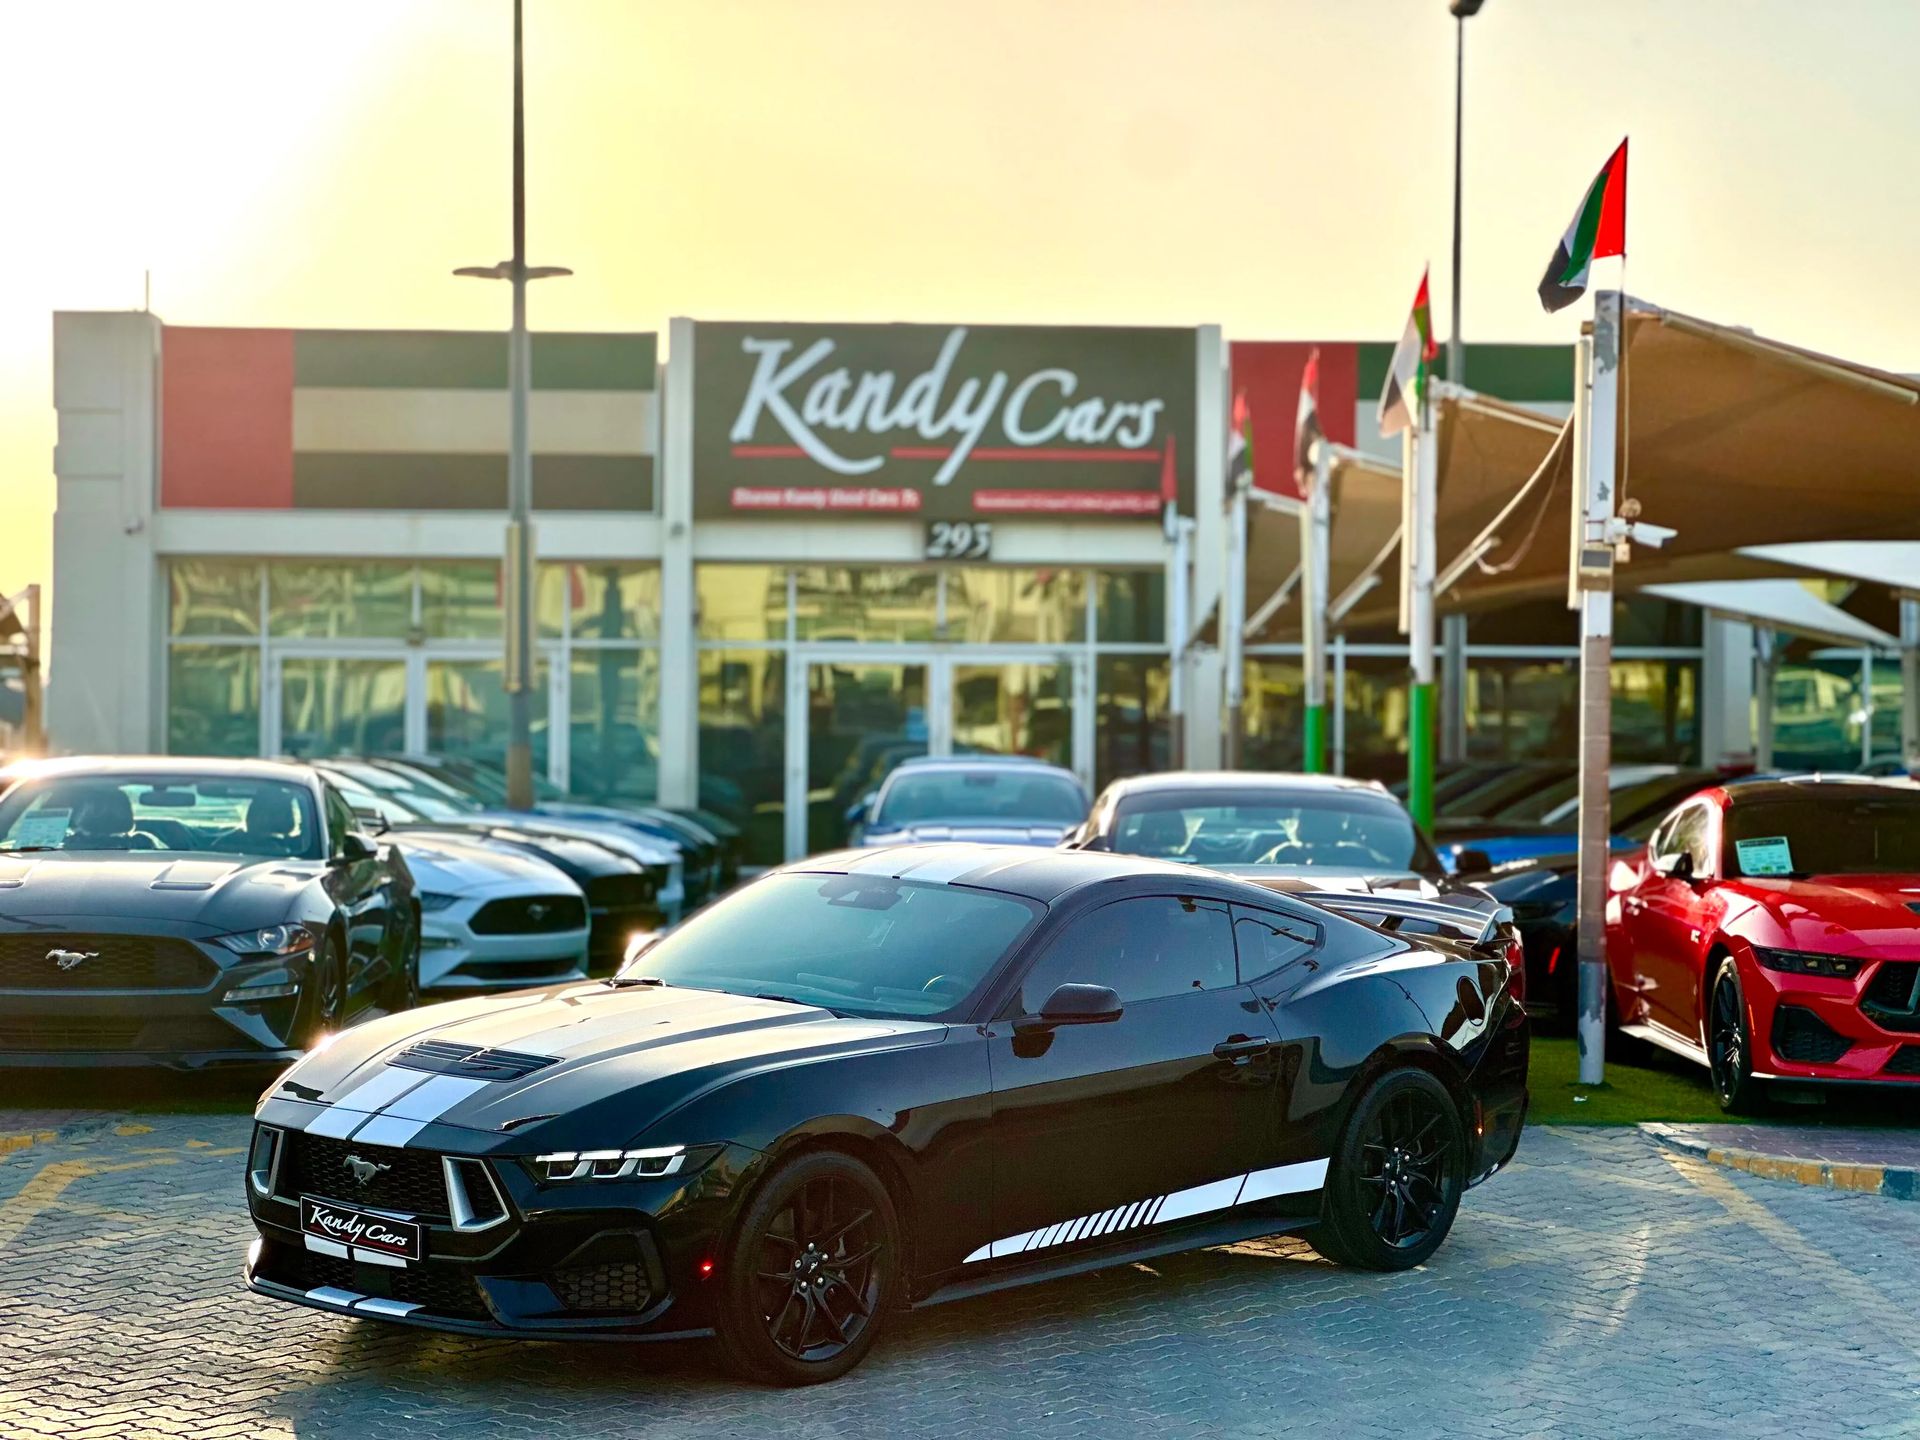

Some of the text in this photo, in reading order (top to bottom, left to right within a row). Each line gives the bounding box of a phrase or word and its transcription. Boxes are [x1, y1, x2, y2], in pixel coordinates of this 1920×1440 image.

[730, 327, 1164, 486] Kandy Cars
[928, 522, 991, 558] 295
[310, 1205, 407, 1246] Kandy Cars
